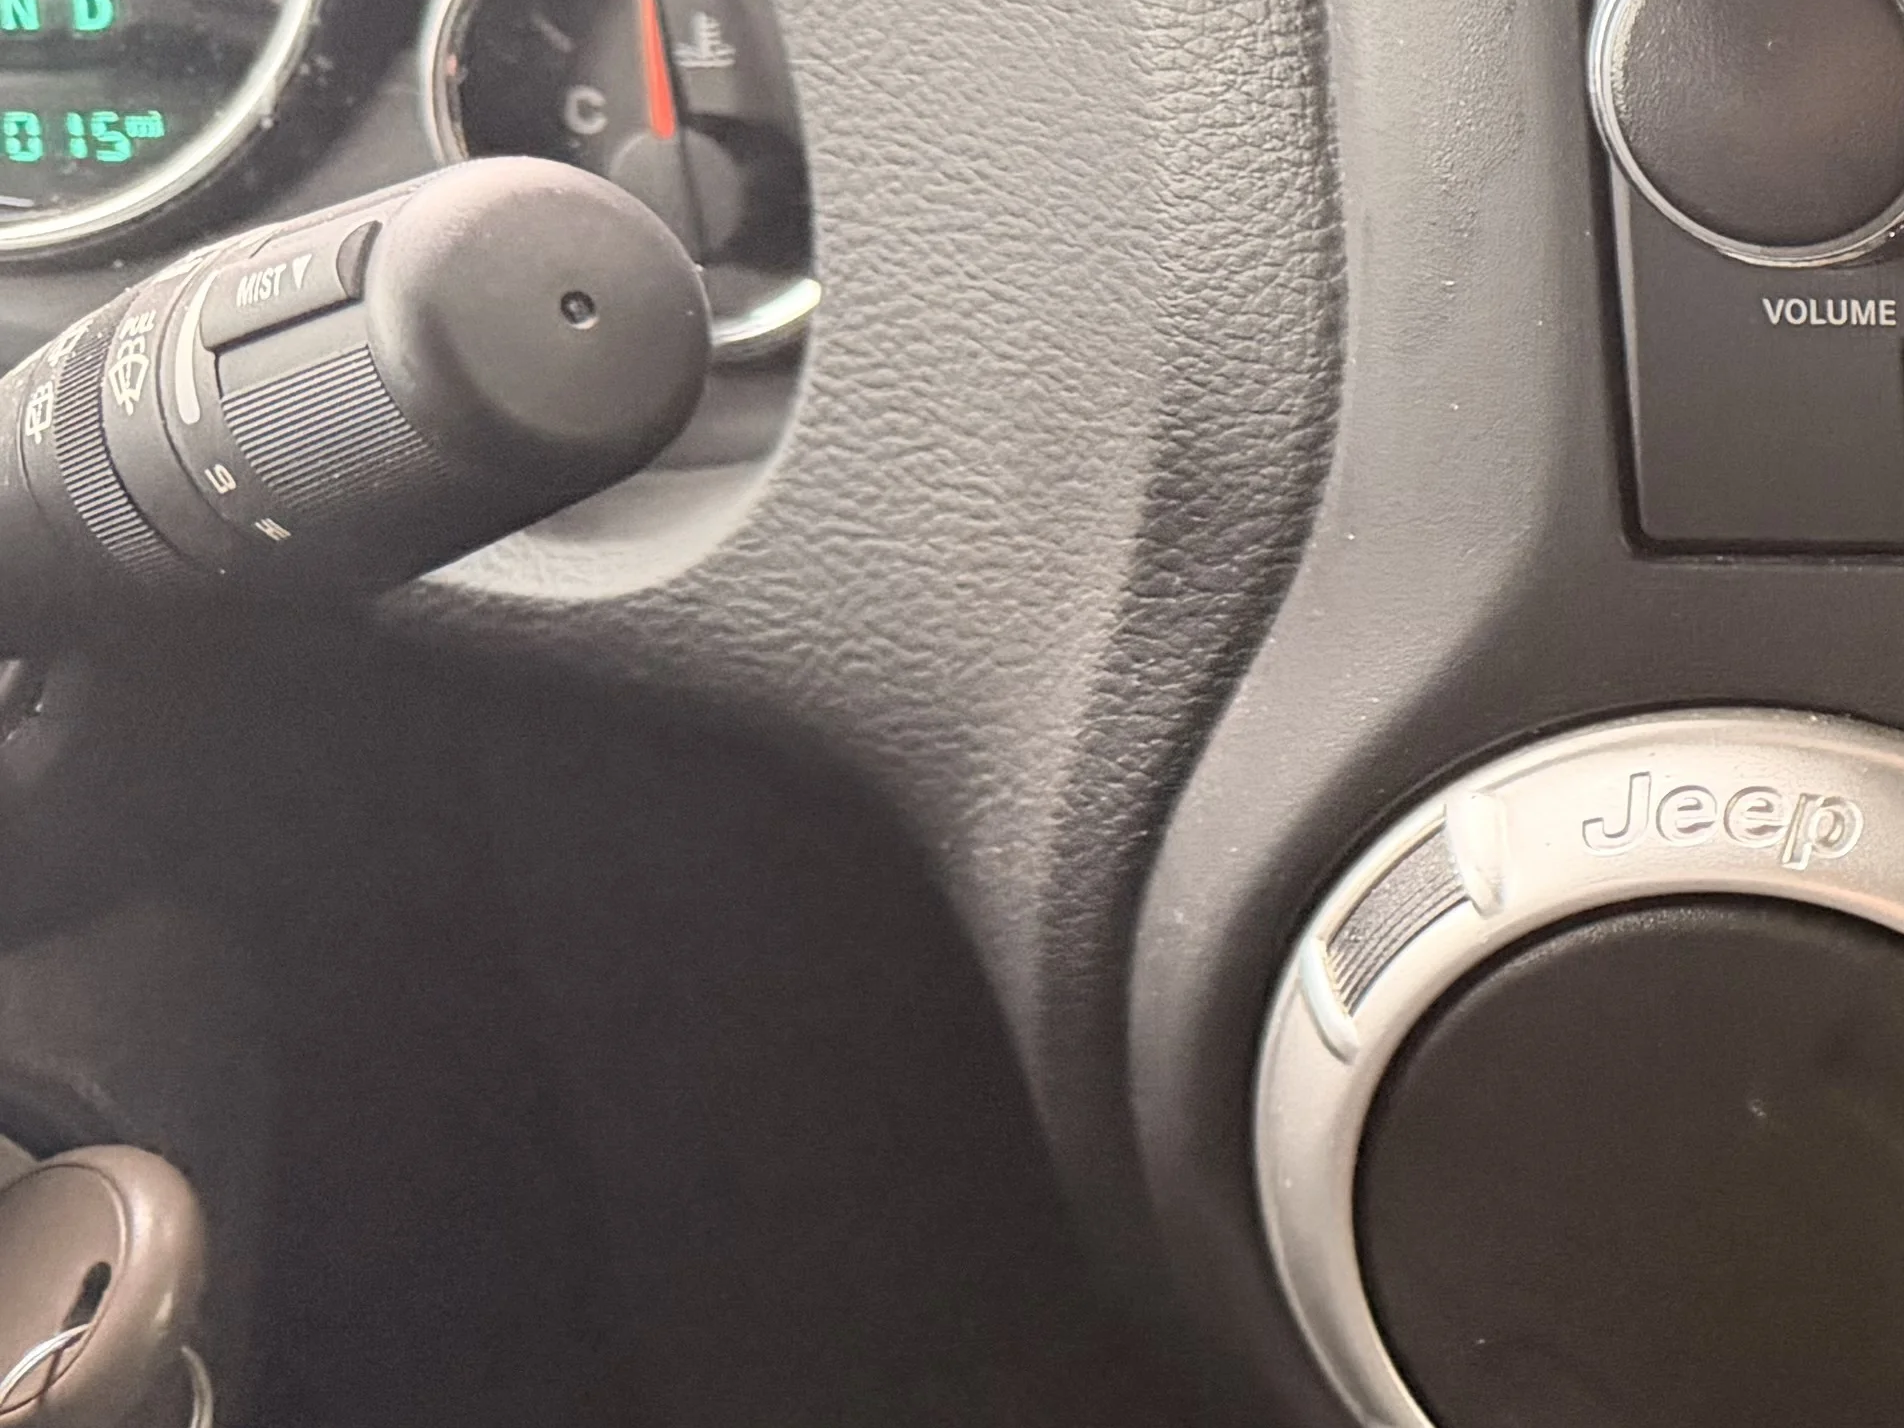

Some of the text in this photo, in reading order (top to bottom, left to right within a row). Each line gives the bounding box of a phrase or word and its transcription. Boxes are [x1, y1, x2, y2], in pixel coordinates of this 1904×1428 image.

[564, 85, 607, 135] C
[236, 263, 287, 307] MIST
[1762, 298, 1897, 326] VOLUME
[1581, 770, 1864, 870] Jeep
